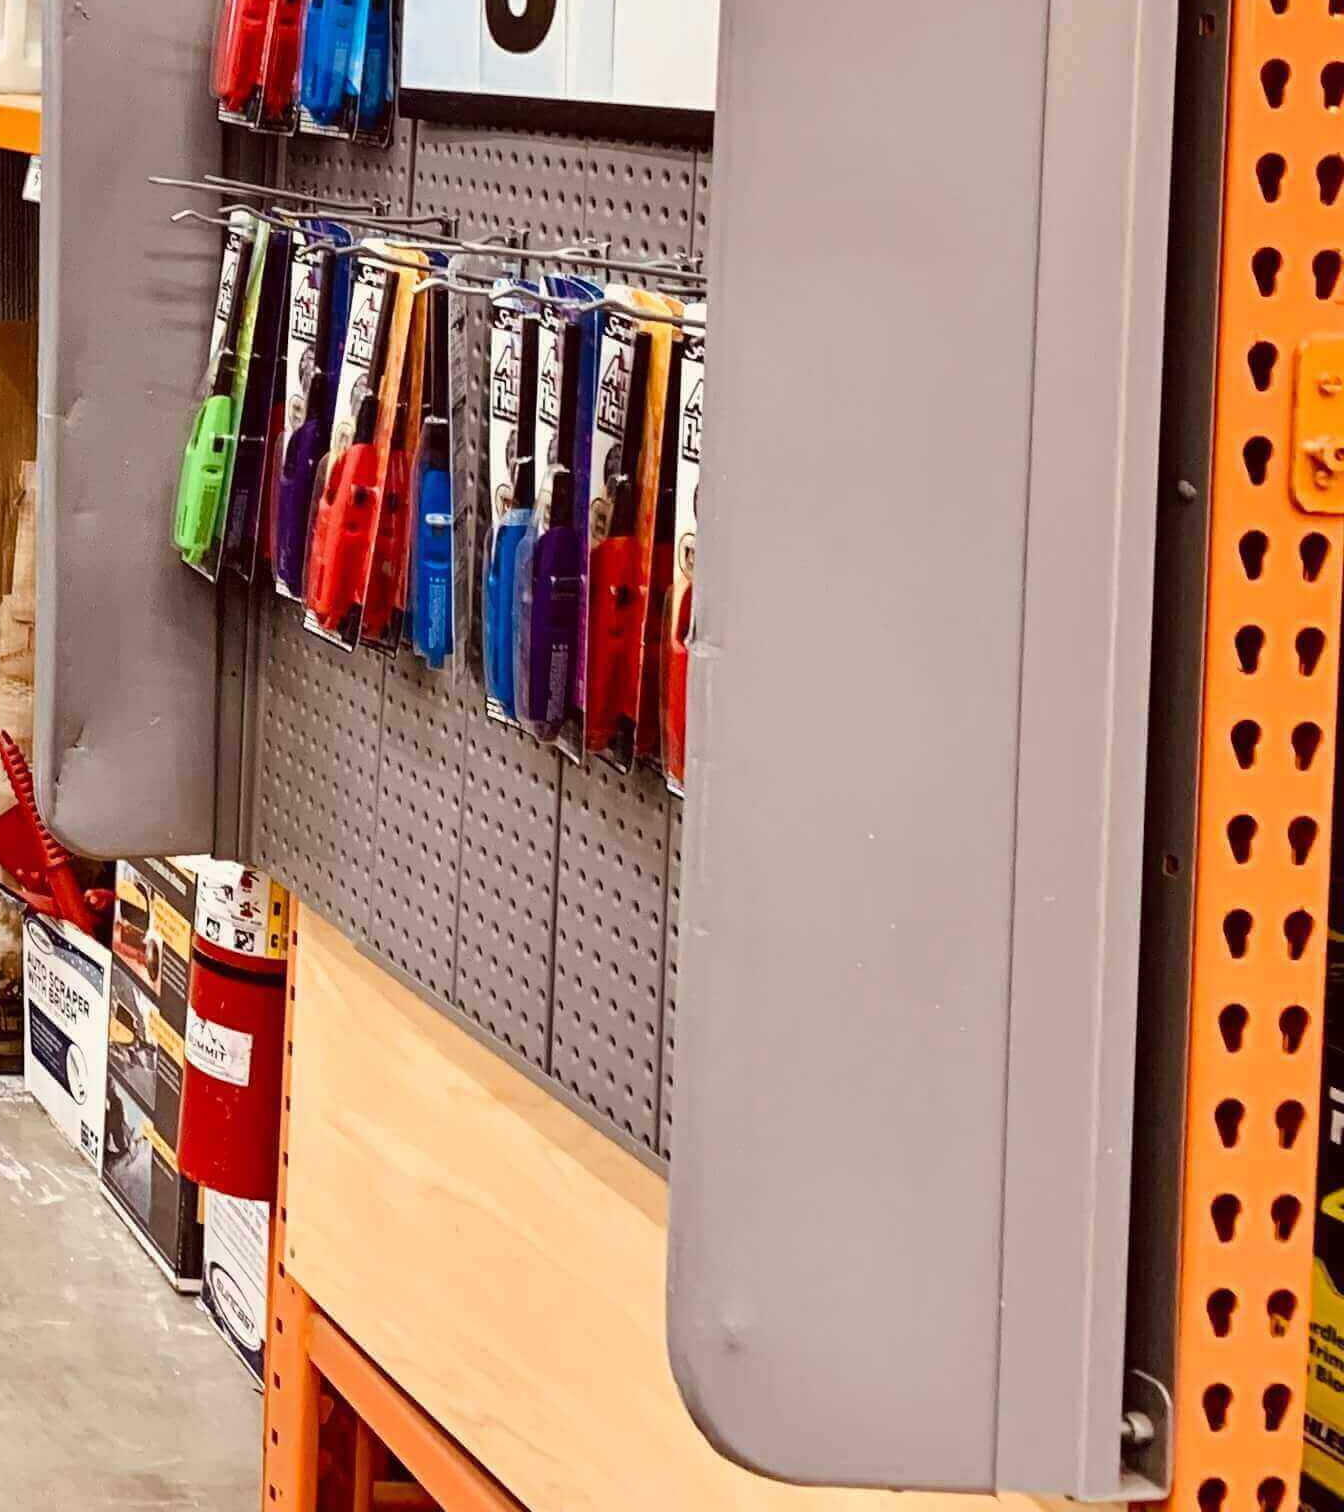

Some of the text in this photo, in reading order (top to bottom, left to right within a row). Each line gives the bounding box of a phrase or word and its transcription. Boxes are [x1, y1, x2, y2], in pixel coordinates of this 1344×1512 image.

[27, 951, 91, 1018] AUTO SCRAPER
[48, 986, 78, 1024] BRUSH
